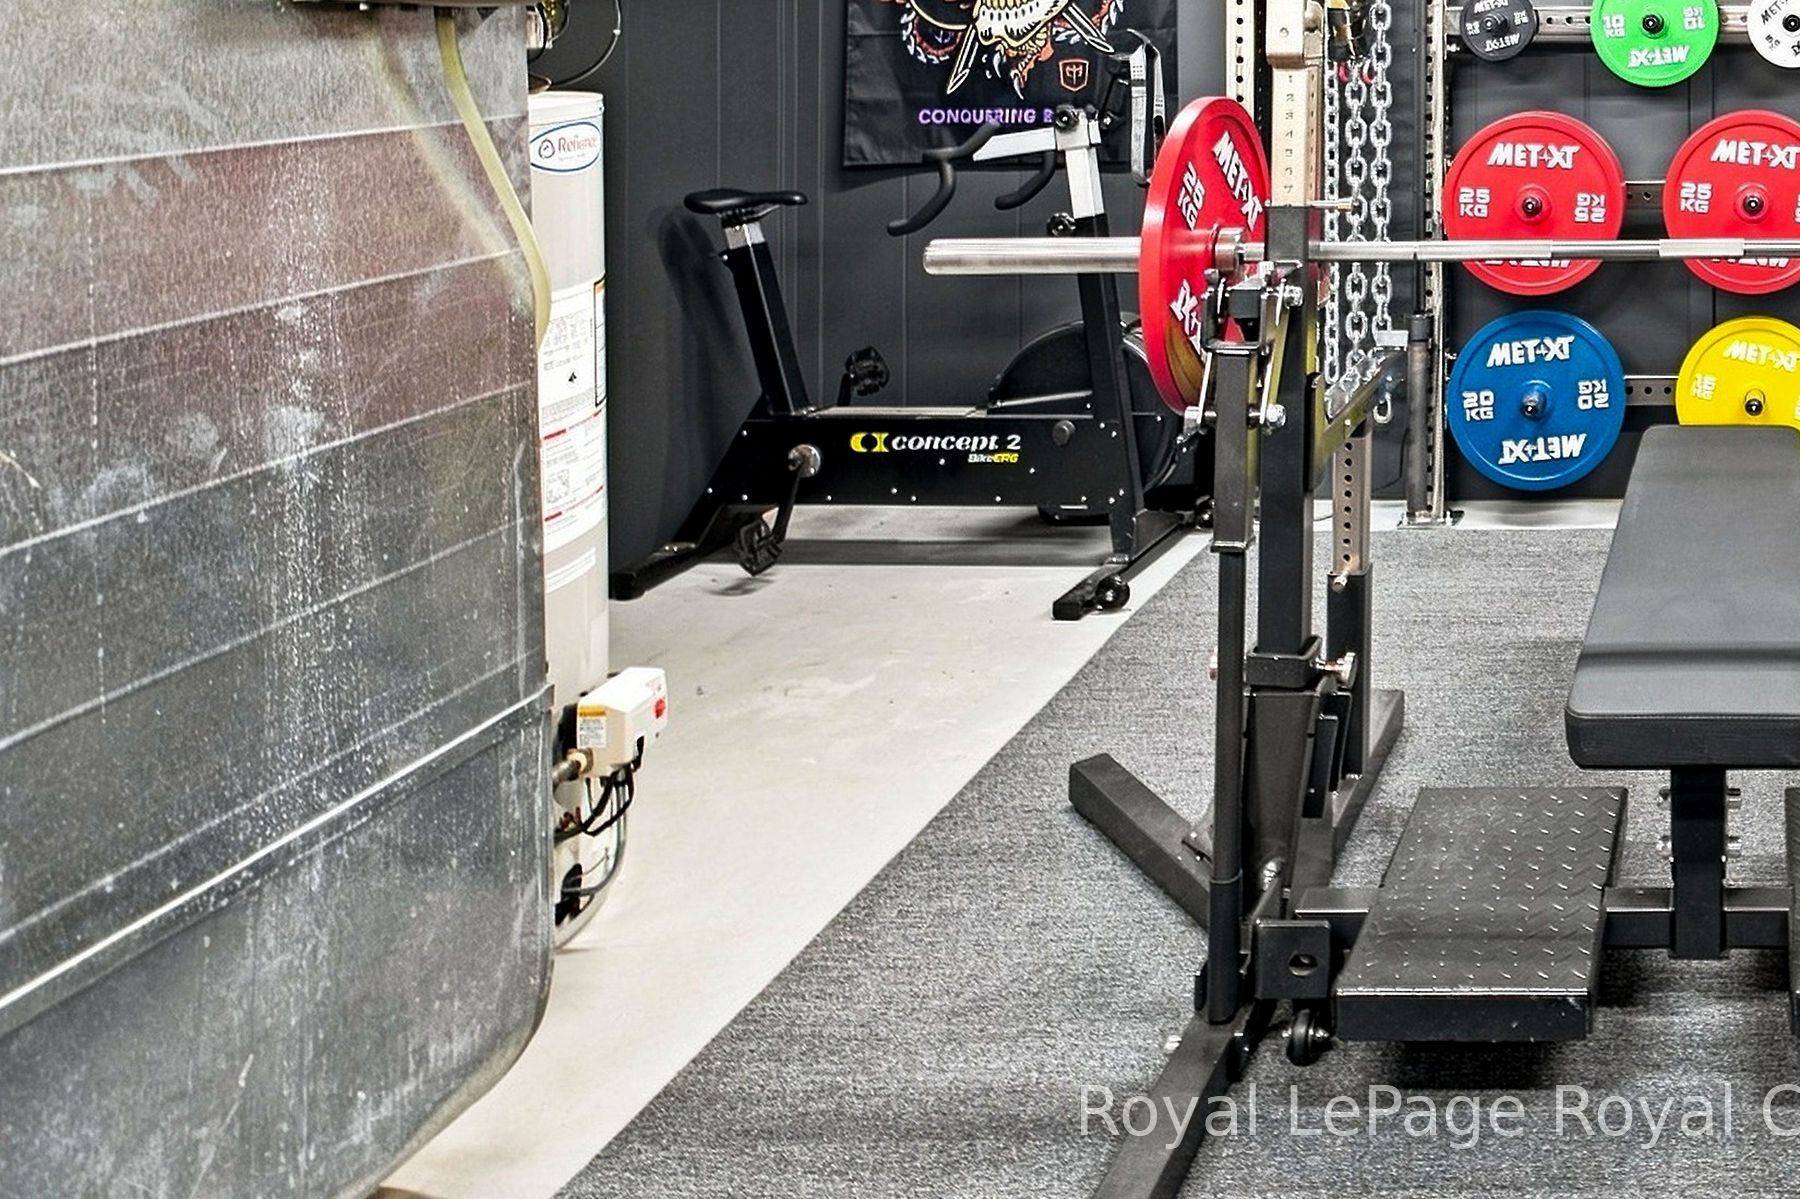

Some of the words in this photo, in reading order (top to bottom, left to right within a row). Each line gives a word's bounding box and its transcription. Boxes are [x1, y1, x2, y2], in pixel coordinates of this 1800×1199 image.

[1602, 13, 1626, 27] 10
[1603, 26, 1627, 38] KG
[918, 108, 1037, 125] CONQUERING
[1182, 161, 1206, 208] 25
[1680, 182, 1712, 198] 25
[1458, 186, 1490, 202] 25
[1576, 192, 1606, 207] KG
[1177, 187, 1198, 231] KG
[1460, 202, 1489, 218] KG
[1680, 197, 1710, 213] KG
[1574, 206, 1606, 223] 25
[1578, 379, 1608, 393] KG
[1462, 390, 1495, 406] 20
[1577, 392, 1609, 410] 20
[1464, 404, 1494, 421] KG
[891, 435, 1000, 453] concept
[1006, 434, 1022, 451] 2
